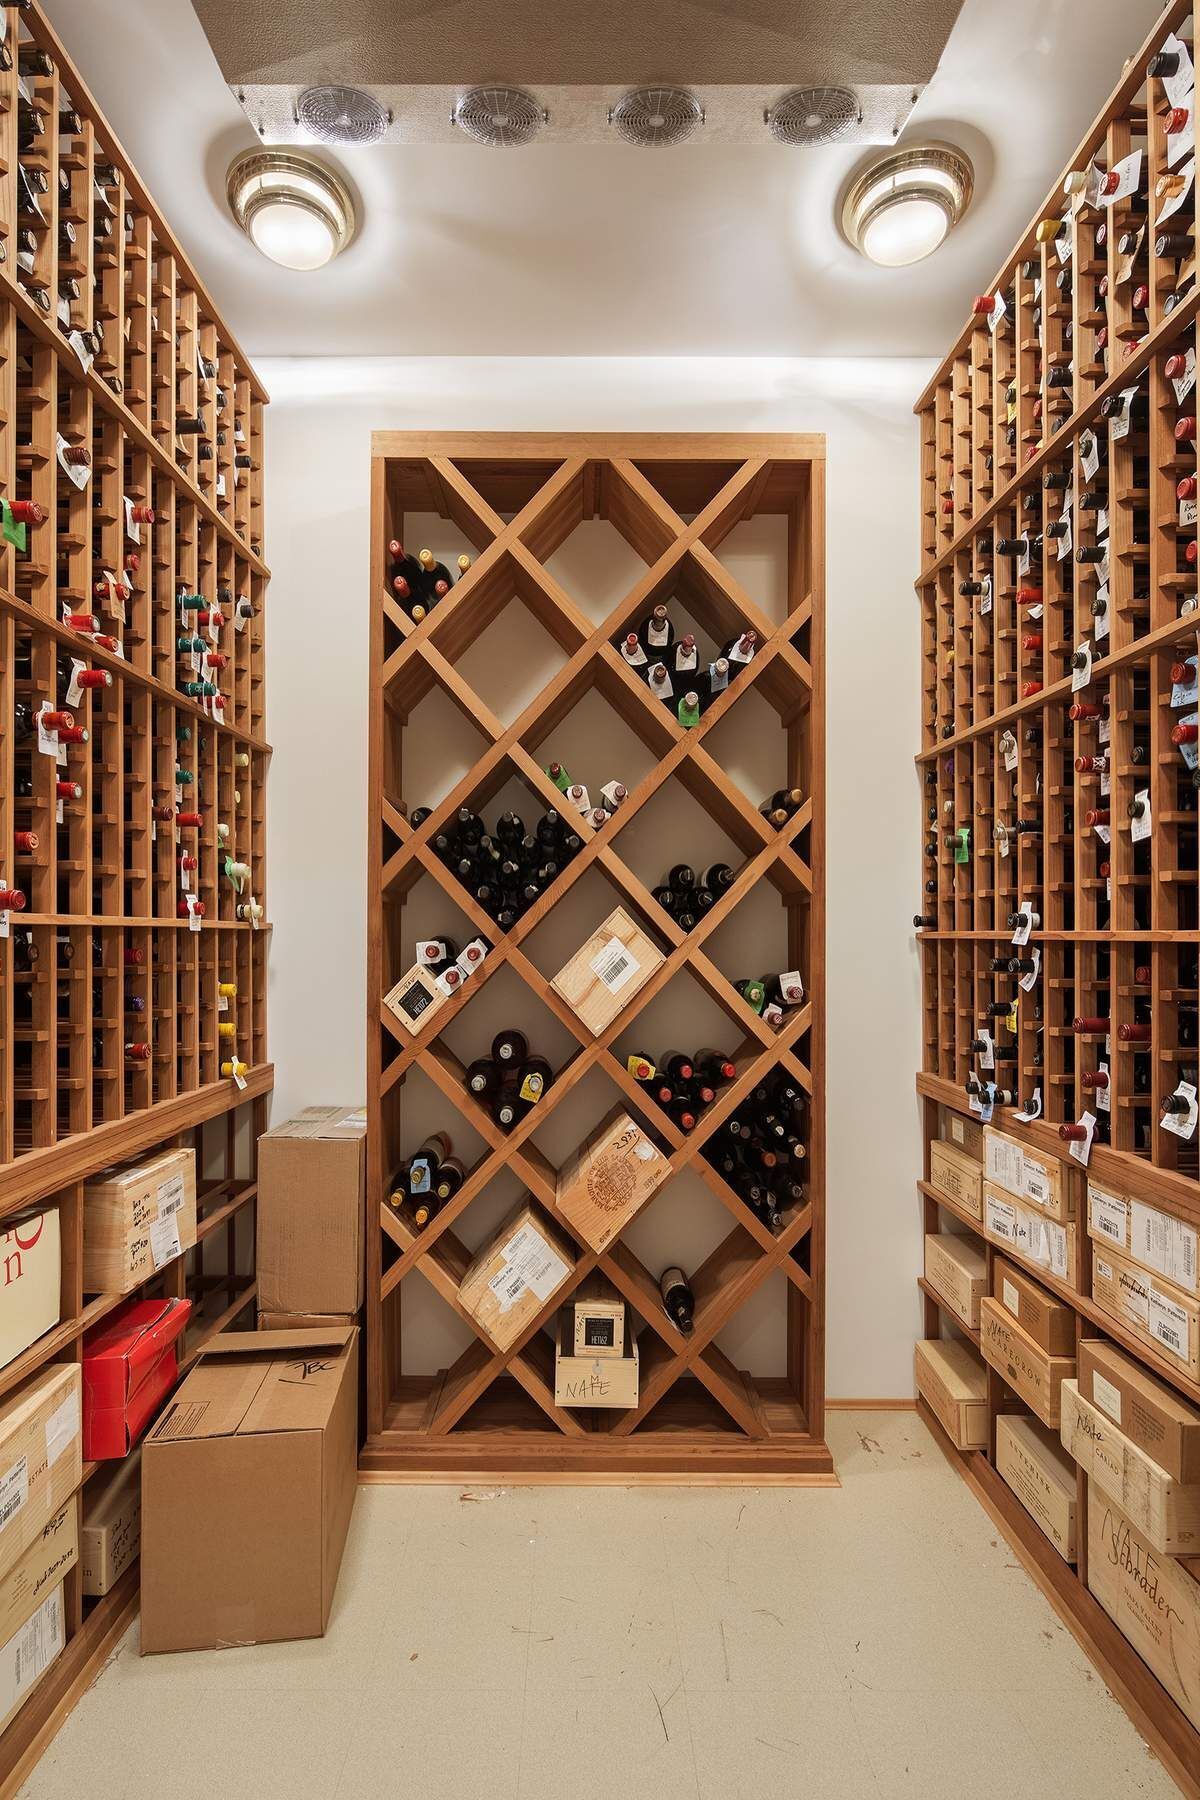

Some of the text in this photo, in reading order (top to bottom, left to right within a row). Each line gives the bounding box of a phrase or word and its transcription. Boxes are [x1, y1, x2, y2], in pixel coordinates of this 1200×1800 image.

[566, 1379, 611, 1399] NATE
[1077, 1414, 1105, 1442] Nate
[28, 1459, 49, 1487] ESTATE
[1095, 1448, 1119, 1476] CARIAD
[1101, 1508, 1161, 1580] NATE
[1107, 1531, 1185, 1625] Schrader
